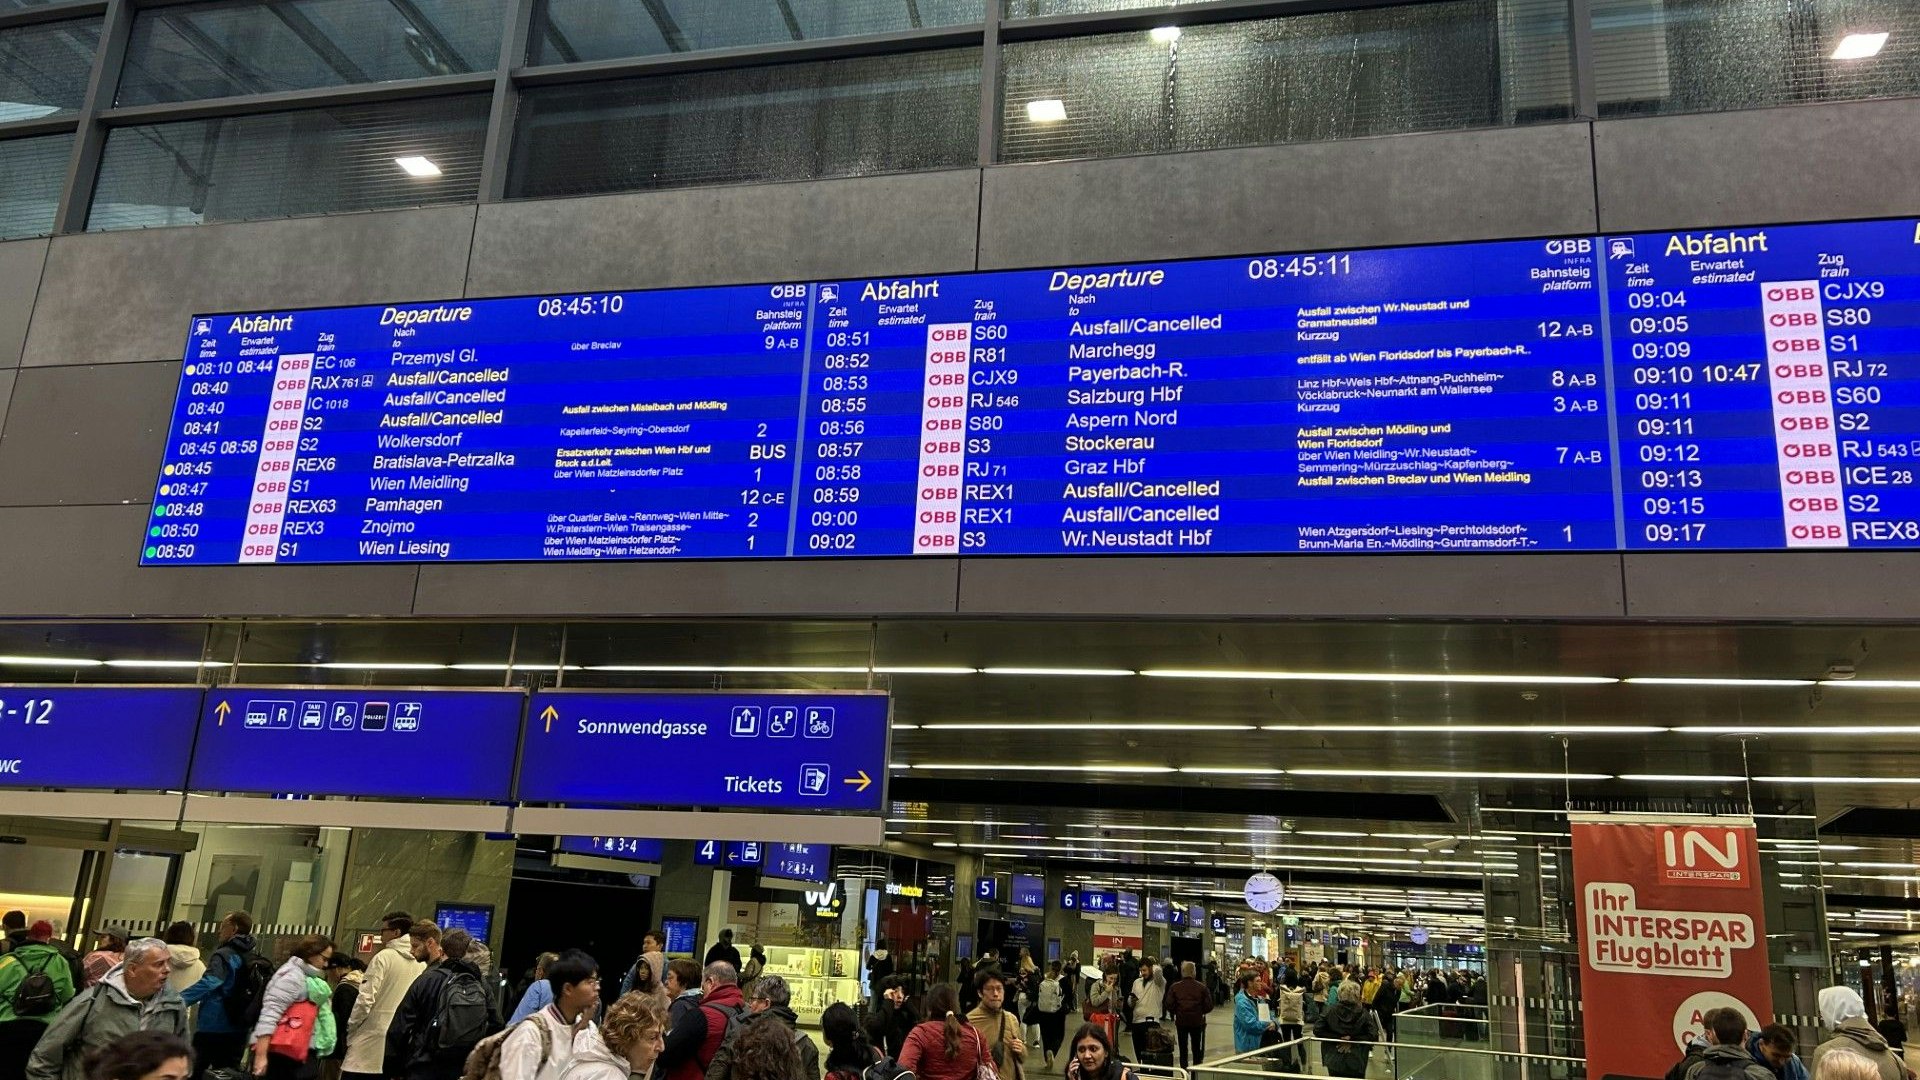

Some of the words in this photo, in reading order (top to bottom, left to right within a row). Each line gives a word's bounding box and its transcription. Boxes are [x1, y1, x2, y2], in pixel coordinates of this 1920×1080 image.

[1665, 232, 1768, 256] Abfahrt
[1249, 255, 1349, 279] 08:45:11
[1691, 259, 1744, 271] Erwartet
[1818, 254, 1844, 268] Zug
[1626, 264, 1649, 274] Zeit
[1821, 264, 1849, 277] train
[1049, 269, 1164, 293] Departure
[1693, 271, 1755, 284] estimated
[861, 280, 939, 301] Abfahrt
[1825, 282, 1884, 300] CJX9
[539, 296, 623, 316] 08:45:10
[1629, 291, 1686, 308] 09:04
[756, 309, 802, 320] Bahnsteig
[1297, 307, 1331, 316] Ausfall
[1334, 305, 1381, 315] zwischen
[1383, 301, 1447, 312] Wr.Neustadt
[1450, 300, 1469, 309] und
[228, 315, 293, 333] Abfahrt
[380, 306, 472, 327] Departure
[1298, 316, 1377, 328] Gramatneusiedl
[1827, 308, 1870, 325] S80
[394, 327, 415, 336] Nach
[763, 321, 801, 332] platform
[1070, 314, 1221, 336] Ausfall/Cancelled
[1538, 322, 1561, 337] 12
[1566, 324, 1593, 336] A-B
[1630, 316, 1688, 333] 09:05
[318, 333, 334, 342] Zug
[827, 332, 869, 347] 08:51
[975, 325, 1007, 340] S60
[1298, 332, 1339, 341] Kurzzug
[1632, 342, 1690, 359] 09:09
[1830, 335, 1857, 351] S1
[392, 350, 455, 367] Przemysl
[459, 349, 477, 362] Gl.
[974, 348, 1005, 363] R81
[1070, 343, 1155, 359] Marchegg
[193, 362, 232, 375] 08:10
[237, 360, 272, 373] 08:44
[315, 356, 336, 369] EC
[339, 358, 356, 368] 106
[825, 353, 869, 369] 08:52
[1833, 360, 1862, 377] RJ
[1867, 364, 1887, 376] 72
[387, 368, 508, 386] Ausfall/Cancelled
[972, 370, 1017, 385] CJX9
[1069, 362, 1187, 384] Payerbach-R.
[1634, 366, 1692, 384] 09:10
[1703, 364, 1760, 382] 10:47
[192, 382, 228, 395] 08:40
[311, 376, 340, 389] RJX
[342, 378, 358, 388] 761
[824, 376, 867, 391] 08:53
[384, 389, 506, 406] Ausfall/Cancelled
[1068, 389, 1144, 406] Salzburg
[1151, 386, 1183, 401] Hbf
[1636, 393, 1690, 410] 09:11
[1837, 386, 1880, 404] S60
[188, 402, 224, 415] 08:40
[308, 397, 323, 410] IC
[326, 399, 349, 409] 1018
[822, 398, 866, 412] 08:55
[304, 417, 322, 430] S2
[380, 410, 503, 427] Ausfall/Cancelled
[970, 416, 1002, 430] S80
[1066, 413, 1128, 431] Aspern
[1135, 410, 1177, 425] Nord
[1840, 413, 1870, 430] S2
[184, 421, 219, 435] 08:41
[820, 421, 864, 435] 08:56
[1638, 418, 1692, 435] 09:11
[180, 442, 216, 455] 08:45
[221, 440, 257, 454] 08:58
[300, 438, 318, 451] S2
[378, 432, 463, 448] Wolkersdorf
[1066, 435, 1154, 451] Stockerau
[750, 445, 785, 459] BUS
[818, 442, 863, 457] 08:57
[1640, 445, 1699, 461] 09:12
[1843, 441, 1872, 457] RJ
[1878, 444, 1907, 457] 543
[296, 458, 336, 471] REX6
[373, 452, 514, 469] Bratislava-Petrzalka
[1065, 460, 1107, 474] Graz
[1114, 458, 1145, 473] Hbf
[172, 462, 212, 475] 08:45
[816, 465, 860, 480] 08:58
[1846, 467, 1888, 484] ICE
[1892, 471, 1912, 484] 28
[292, 480, 309, 492] S1
[371, 477, 405, 490] Wien
[410, 475, 469, 492] Meidling
[1298, 476, 1333, 486] Ausfall
[1336, 475, 1384, 485] zwischen
[1387, 474, 1427, 484] Breclav
[1430, 473, 1450, 483] und
[1453, 473, 1482, 482] Wien
[1484, 472, 1530, 483] Meidling
[1642, 470, 1702, 487] 09:13
[168, 482, 208, 496] 08:47
[814, 488, 859, 503] 08:59
[966, 485, 1012, 500] REX1
[1063, 481, 1219, 498] Ausfall/Cancelled
[741, 490, 759, 504] 12
[763, 493, 784, 504] C-E
[1849, 495, 1880, 512] S2
[166, 503, 203, 516] 08:48
[288, 499, 336, 513] REX63
[366, 498, 442, 514] Pamhagen
[1644, 497, 1704, 514] 09:15
[812, 511, 857, 526] 09:00
[964, 508, 1011, 523] REX1
[1062, 505, 1219, 522] Ausfall/Cancelled
[162, 524, 198, 537] 08:50
[284, 521, 324, 535] REX3
[361, 520, 414, 536] Znojmo
[1646, 524, 1705, 541] 09:17
[810, 534, 855, 549] 09:02
[963, 532, 985, 547] S3
[1062, 530, 1173, 546] Wr.Neustadt
[1180, 529, 1212, 545] Hbf
[157, 544, 194, 558] 08:50
[280, 543, 297, 556] S1
[360, 541, 394, 555] Wien
[399, 540, 450, 557] Liesing
[278, 708, 287, 721] R
[335, 706, 345, 721] P
[785, 711, 793, 724] P
[810, 711, 818, 724] P
[578, 719, 707, 738] Sonnwendgasse
[725, 776, 782, 793] Tickets
[618, 838, 637, 852] 3-4
[702, 840, 714, 859] 4
[1664, 831, 1738, 868] IN
[981, 881, 989, 895] 5
[1065, 894, 1072, 906] 6
[1593, 889, 1629, 911] Ihr
[1173, 912, 1180, 921] 7
[1214, 919, 1220, 927] 8
[1595, 915, 1746, 943] INTERSPAR
[1596, 940, 1724, 970] Flugblatt
